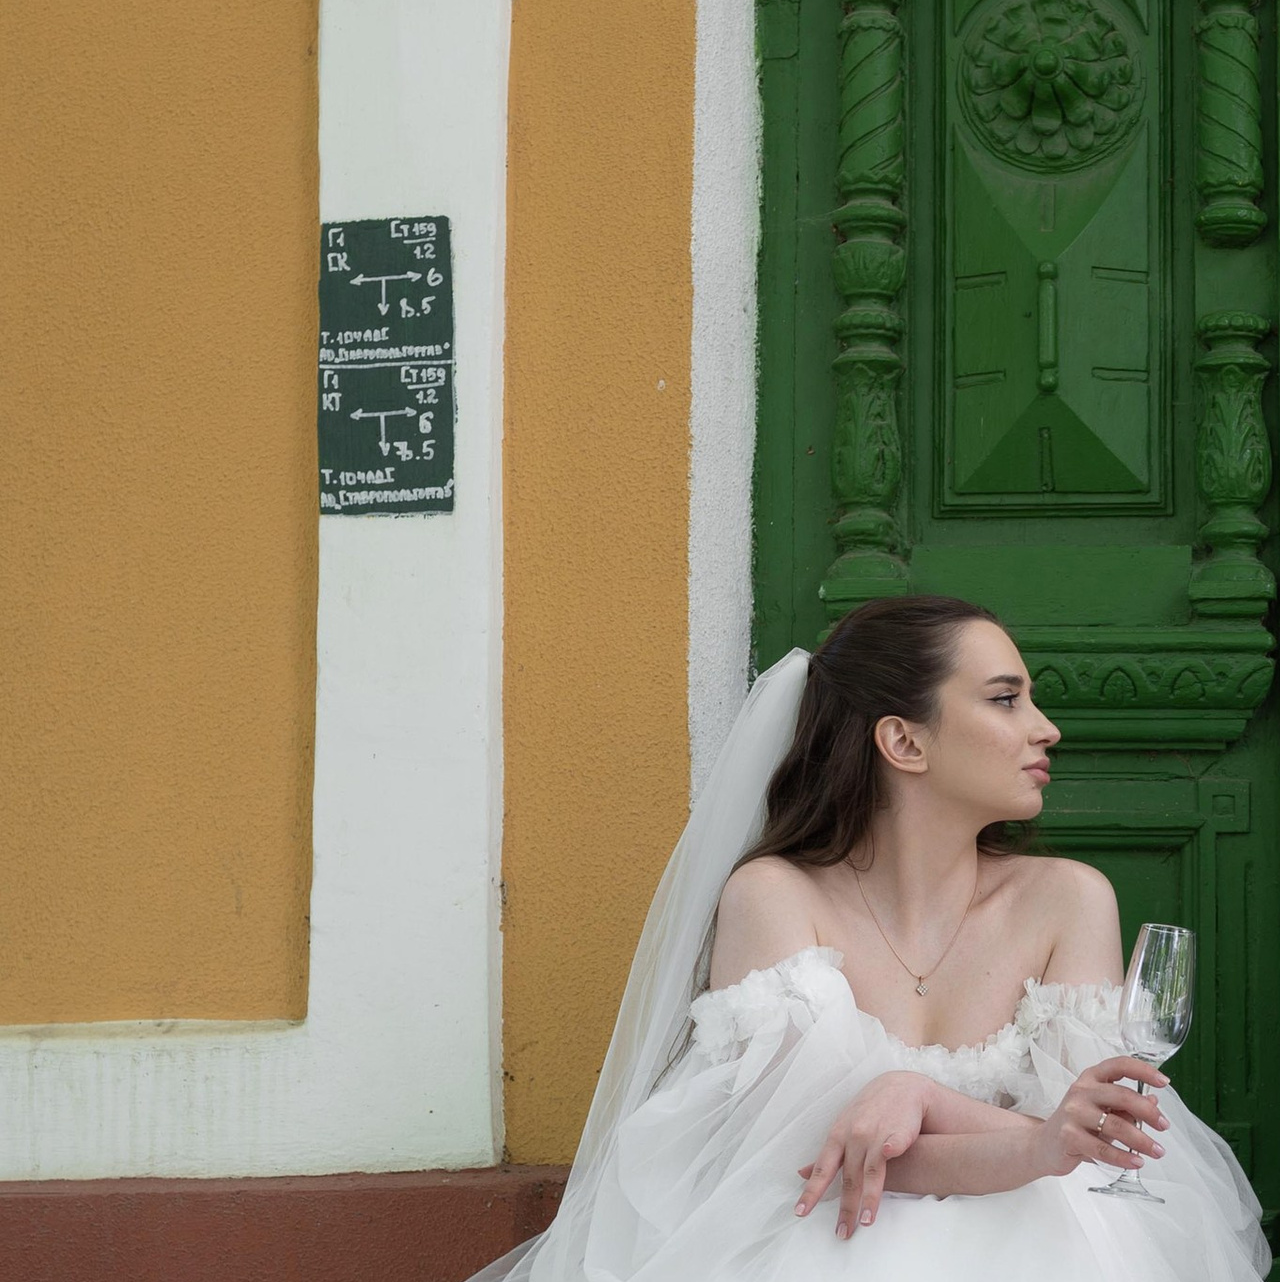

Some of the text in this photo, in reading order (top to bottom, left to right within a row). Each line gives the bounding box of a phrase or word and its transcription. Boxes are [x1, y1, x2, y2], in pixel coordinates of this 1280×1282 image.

[413, 243, 436, 259] 1.2
[427, 267, 444, 286] 6
[416, 388, 439, 404] 1.2
[419, 411, 434, 433] 6
